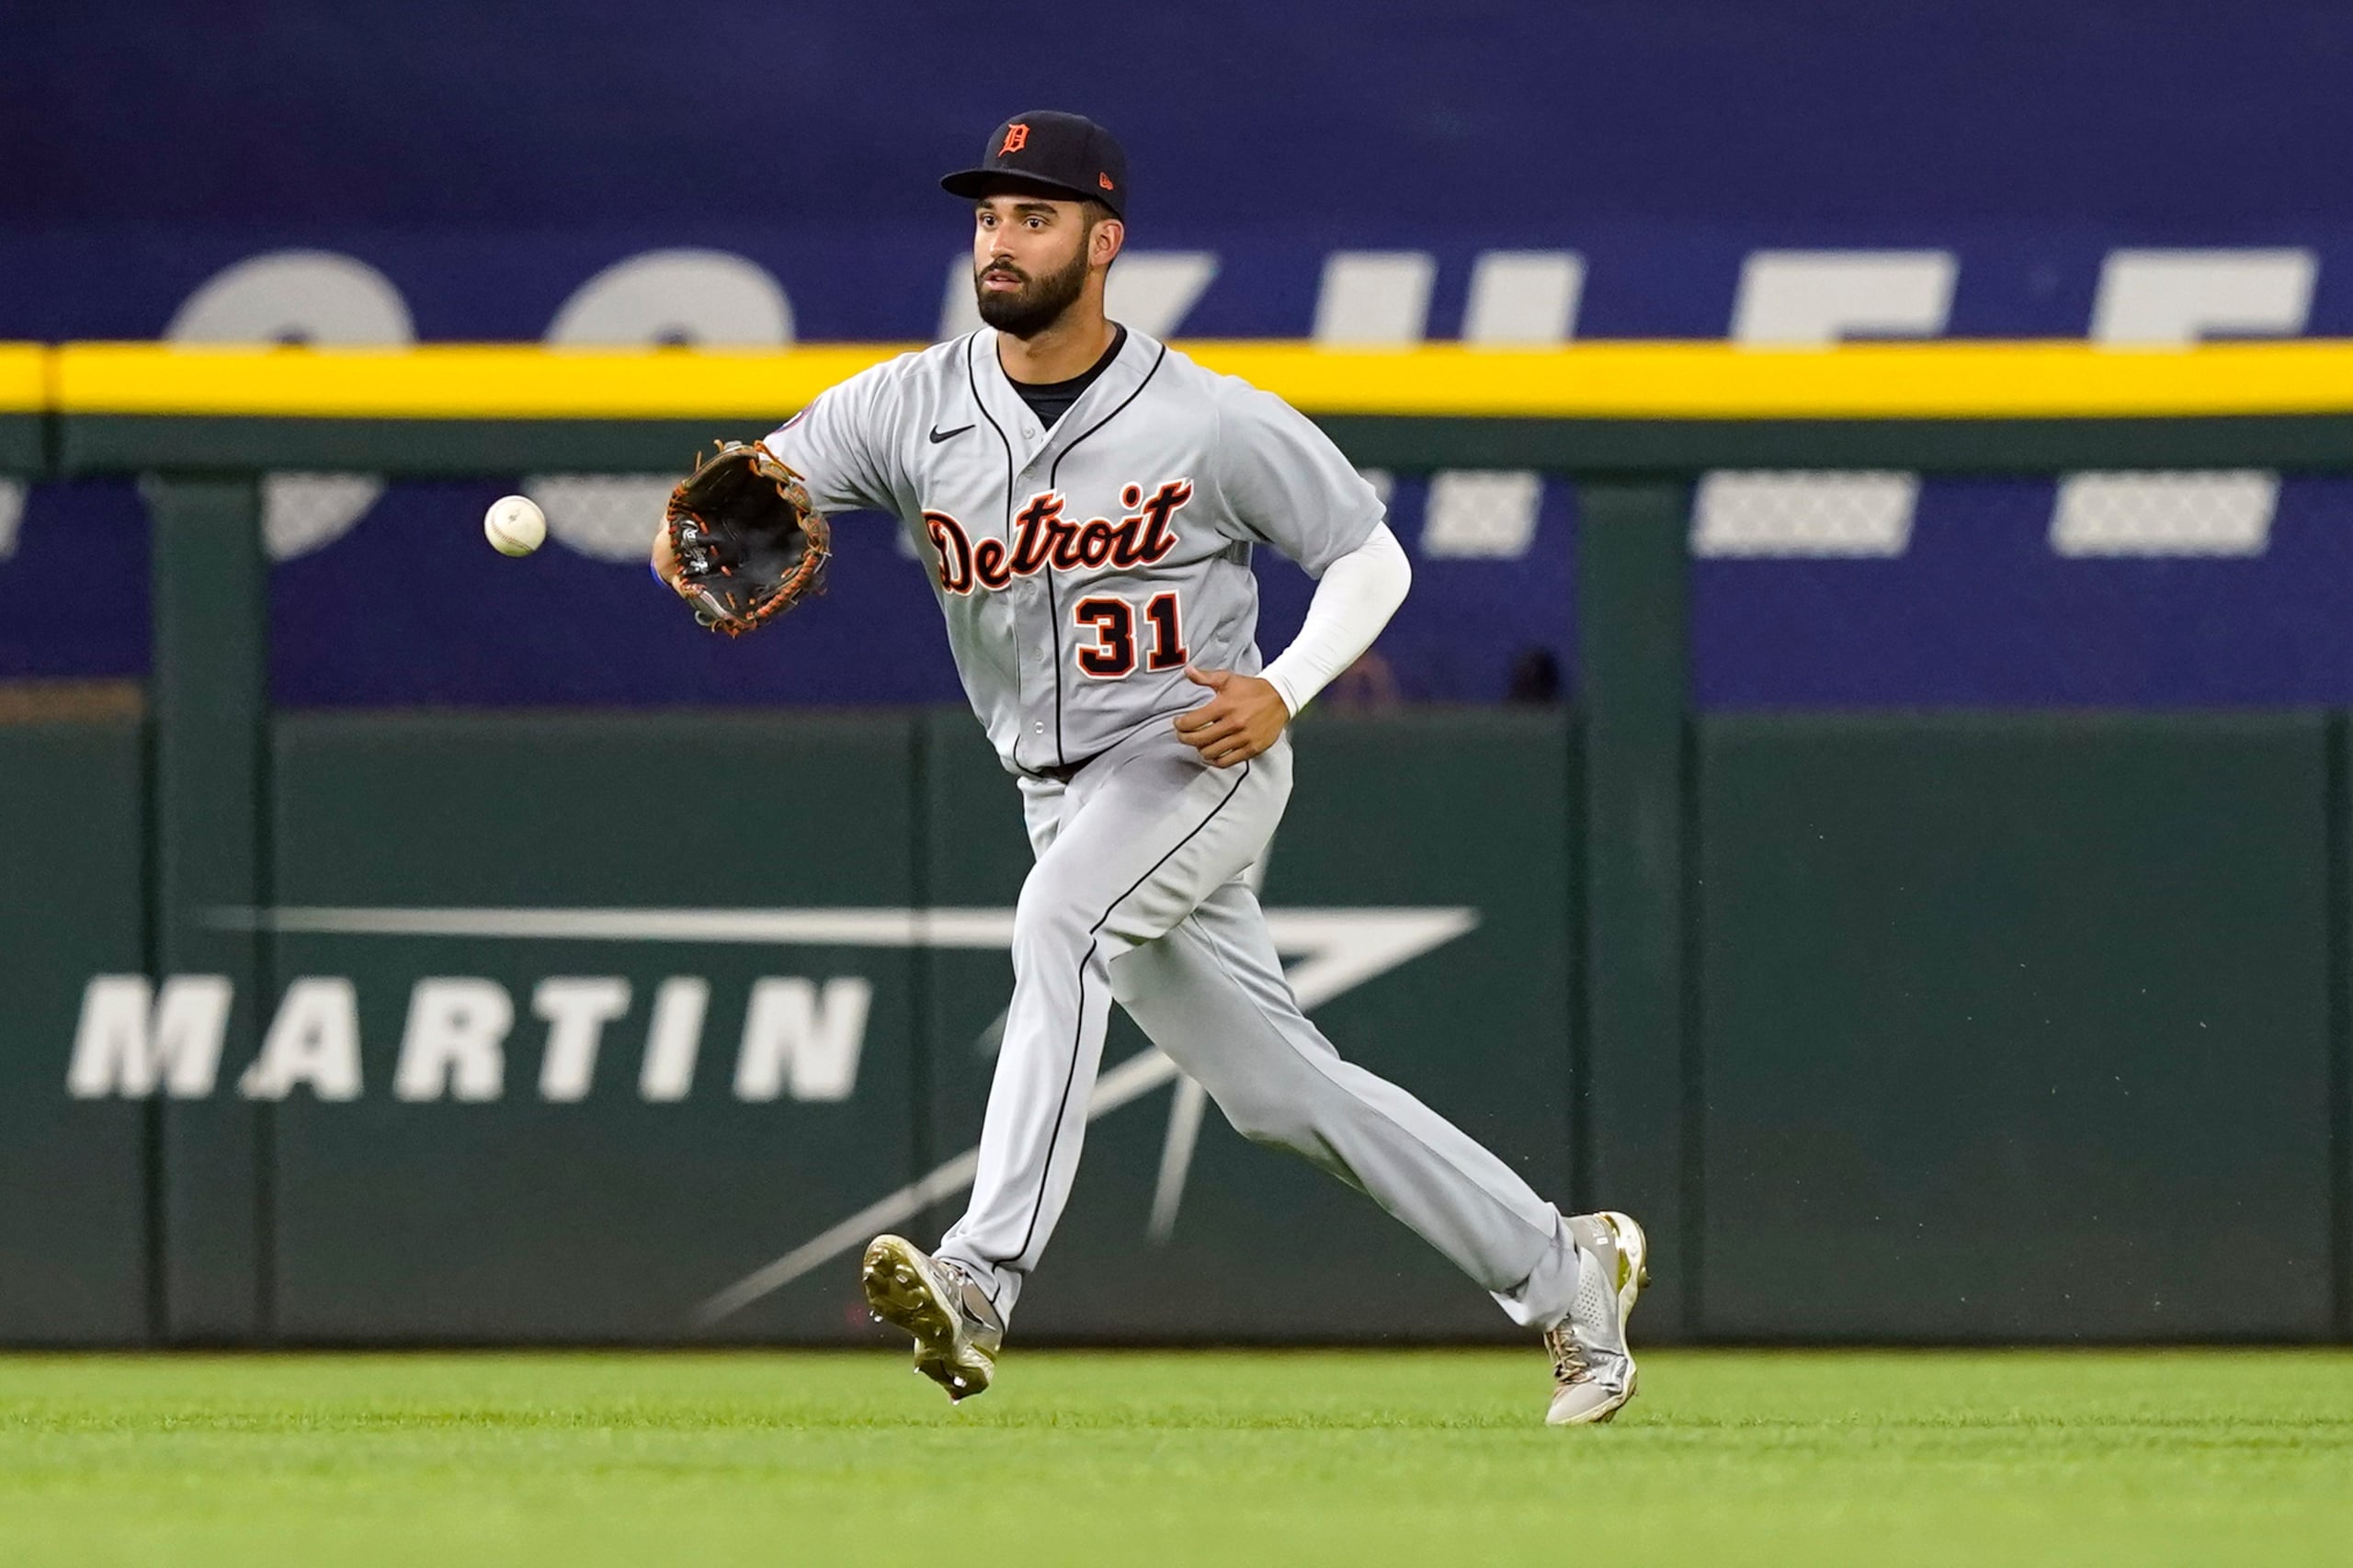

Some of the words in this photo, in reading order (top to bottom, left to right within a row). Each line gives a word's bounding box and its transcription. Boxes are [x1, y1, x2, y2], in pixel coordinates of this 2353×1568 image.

[997, 123, 1030, 157] D
[921, 477, 1193, 595] Detroit
[1074, 590, 1189, 680] 31
[67, 974, 872, 1101] MARTIN
